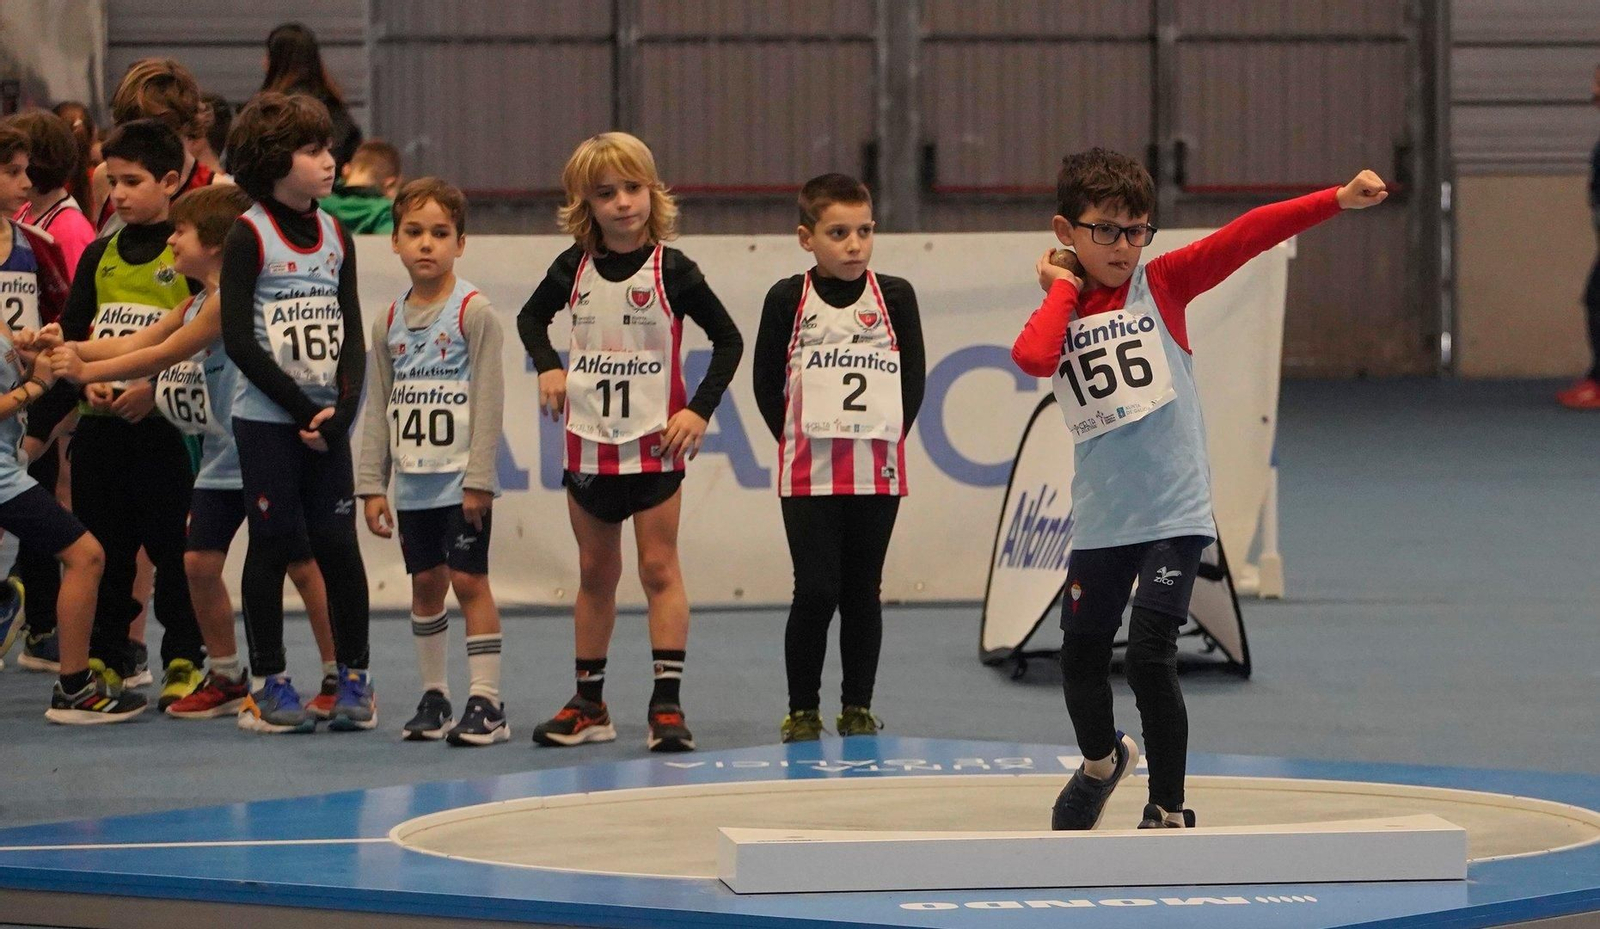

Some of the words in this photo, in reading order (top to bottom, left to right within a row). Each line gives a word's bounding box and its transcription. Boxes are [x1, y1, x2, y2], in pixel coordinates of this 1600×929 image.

[283, 324, 341, 361] 165
[573, 355, 662, 376] Atlántico
[804, 349, 898, 374] Atlántico
[1058, 339, 1153, 407] 156
[162, 387, 208, 425] 163
[390, 384, 468, 405] Atlántico
[596, 379, 630, 418] 11
[842, 372, 867, 412] 2
[392, 408, 455, 448] 140
[898, 896, 1252, 911] MONDO
